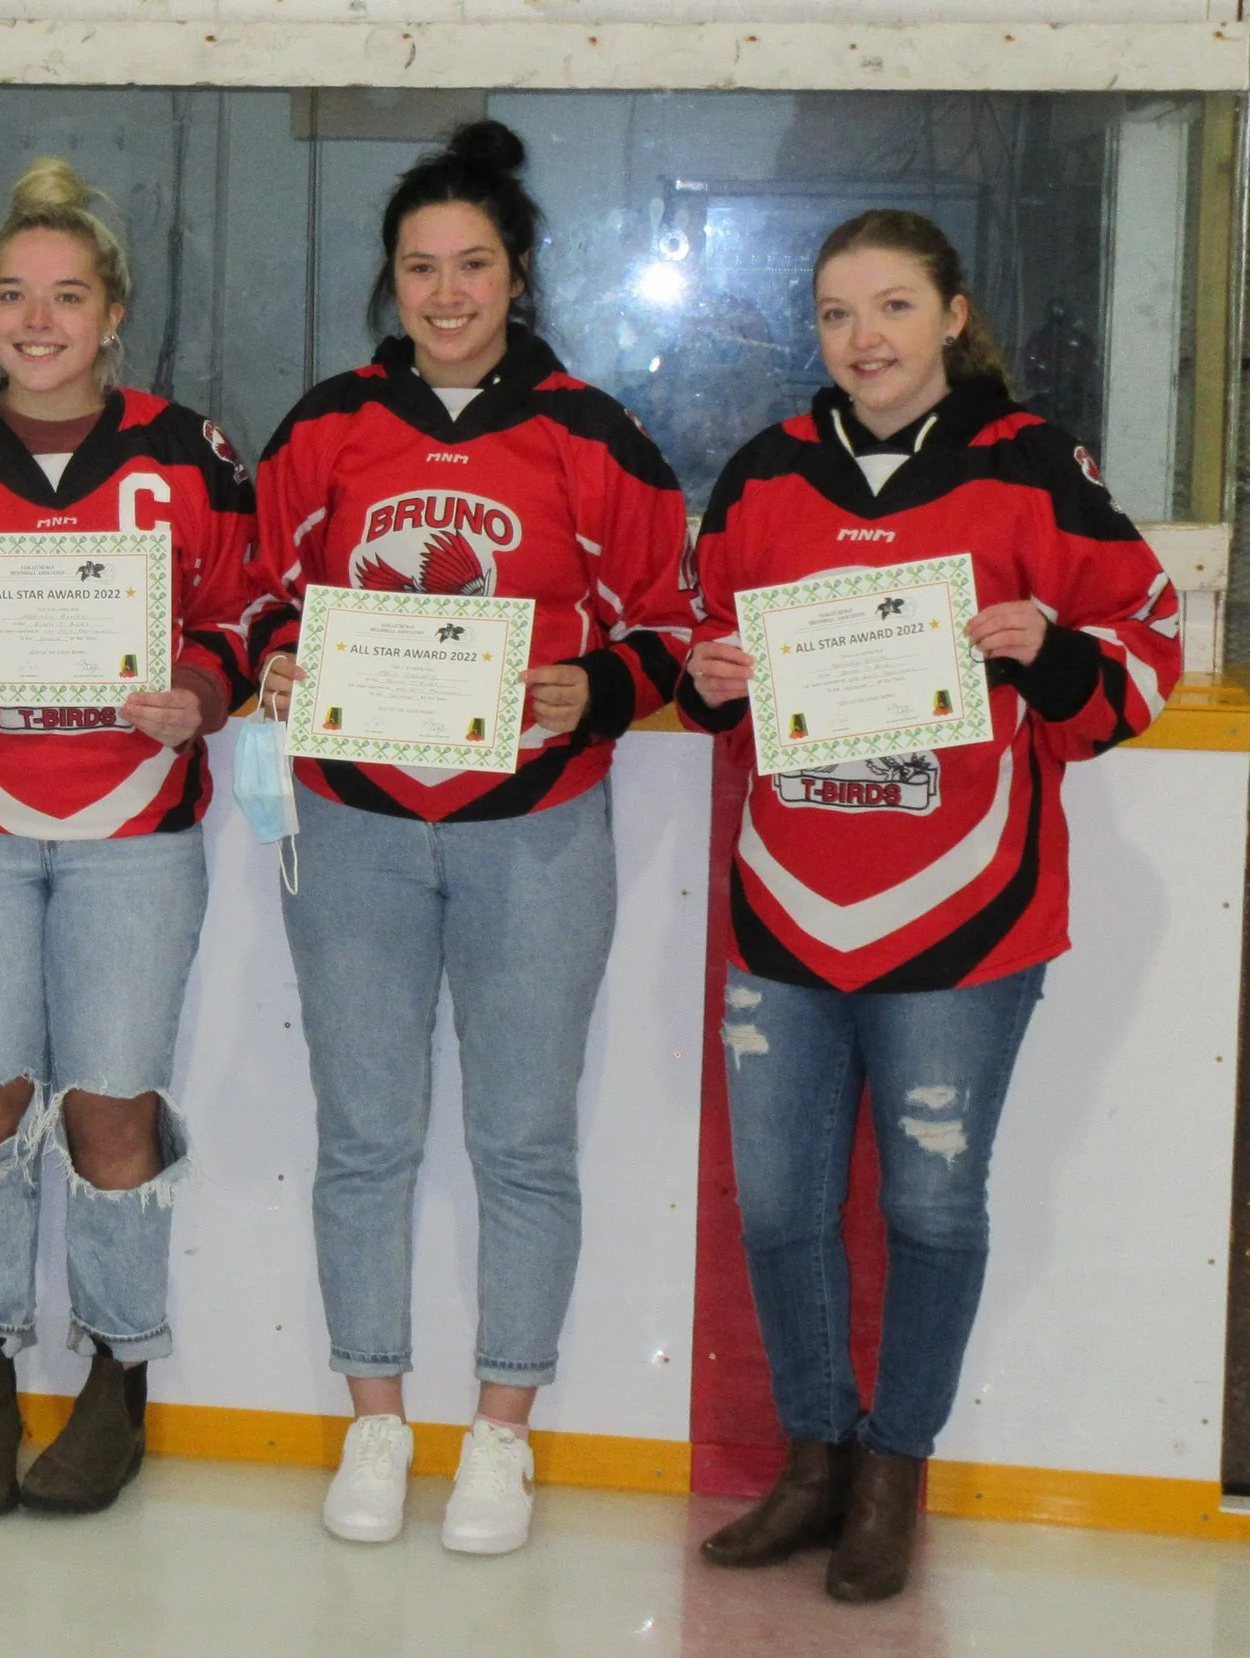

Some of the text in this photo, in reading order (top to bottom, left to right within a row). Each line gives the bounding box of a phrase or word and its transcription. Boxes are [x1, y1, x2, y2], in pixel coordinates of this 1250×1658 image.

[426, 452, 469, 464] MNM
[119, 472, 171, 532] C
[366, 496, 514, 546] BRUNO
[837, 528, 896, 543] MNM
[16, 590, 44, 600] STAR
[47, 590, 90, 599] AWARD
[94, 589, 121, 599] 2022
[796, 622, 925, 654] ALL STAR AWARD 2022
[350, 644, 477, 662] ALL STAR AWARD 2022
[18, 707, 117, 729] T-BIRDS
[801, 778, 903, 805] T-BIRDS
